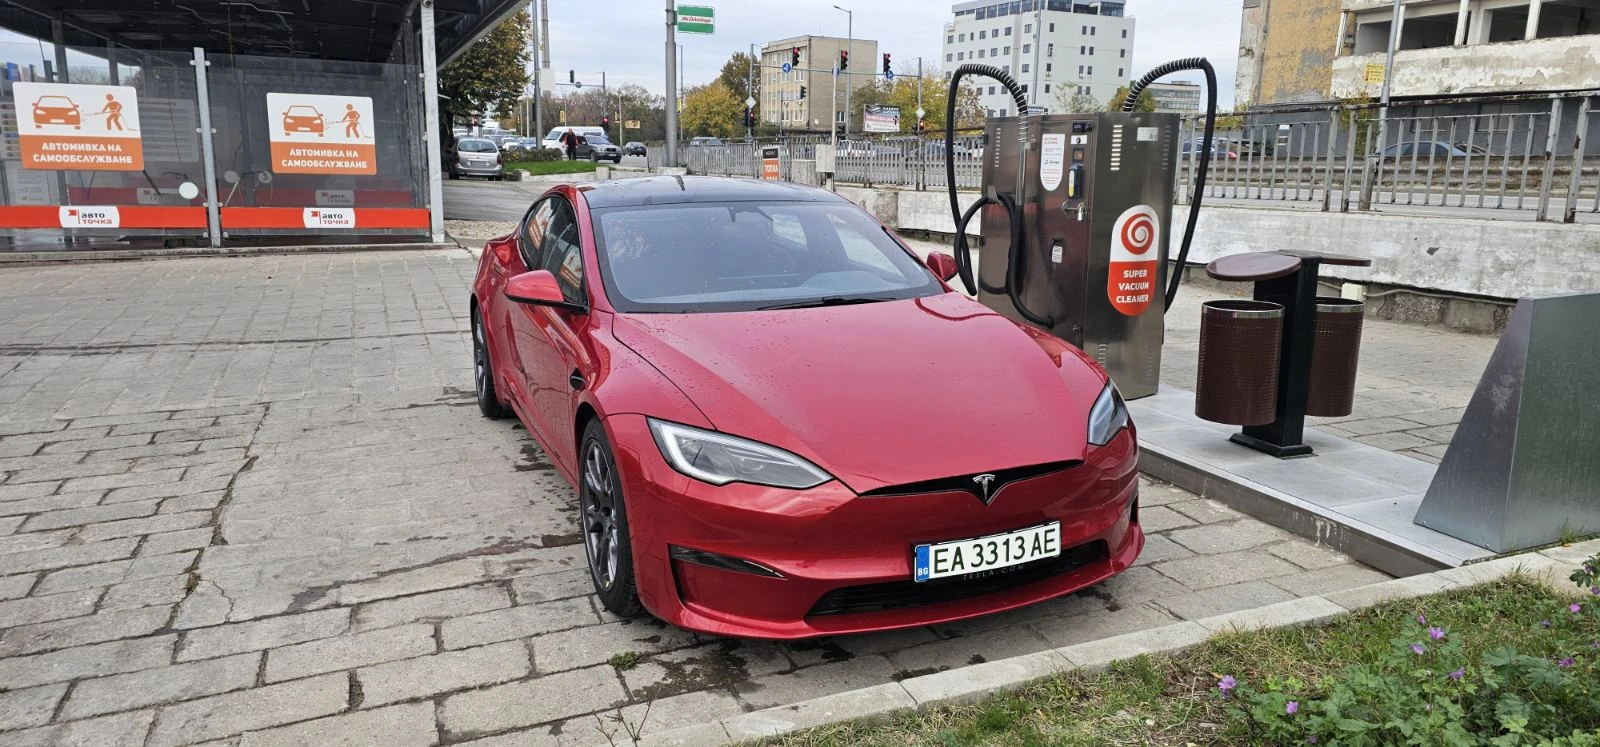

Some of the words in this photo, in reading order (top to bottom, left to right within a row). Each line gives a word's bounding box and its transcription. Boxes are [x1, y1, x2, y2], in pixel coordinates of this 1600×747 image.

[42, 142, 106, 152] АВТОМИВКА
[107, 144, 122, 152] НА
[289, 148, 345, 158] АВТОМИВКА
[346, 150, 359, 158] НА
[33, 153, 133, 164] САМООБСЛУЖВАНЕ
[281, 159, 368, 169] САМООБСЛУЖВАНЕ
[1123, 269, 1148, 278] SUPER
[1118, 281, 1150, 291] VACUUM
[1115, 294, 1150, 304] CLEANER
[934, 547, 965, 574] EA
[970, 535, 1026, 568] 3313
[1030, 527, 1057, 557] AE
[917, 566, 929, 577] BG
[963, 564, 1024, 581] TESLA.COM
